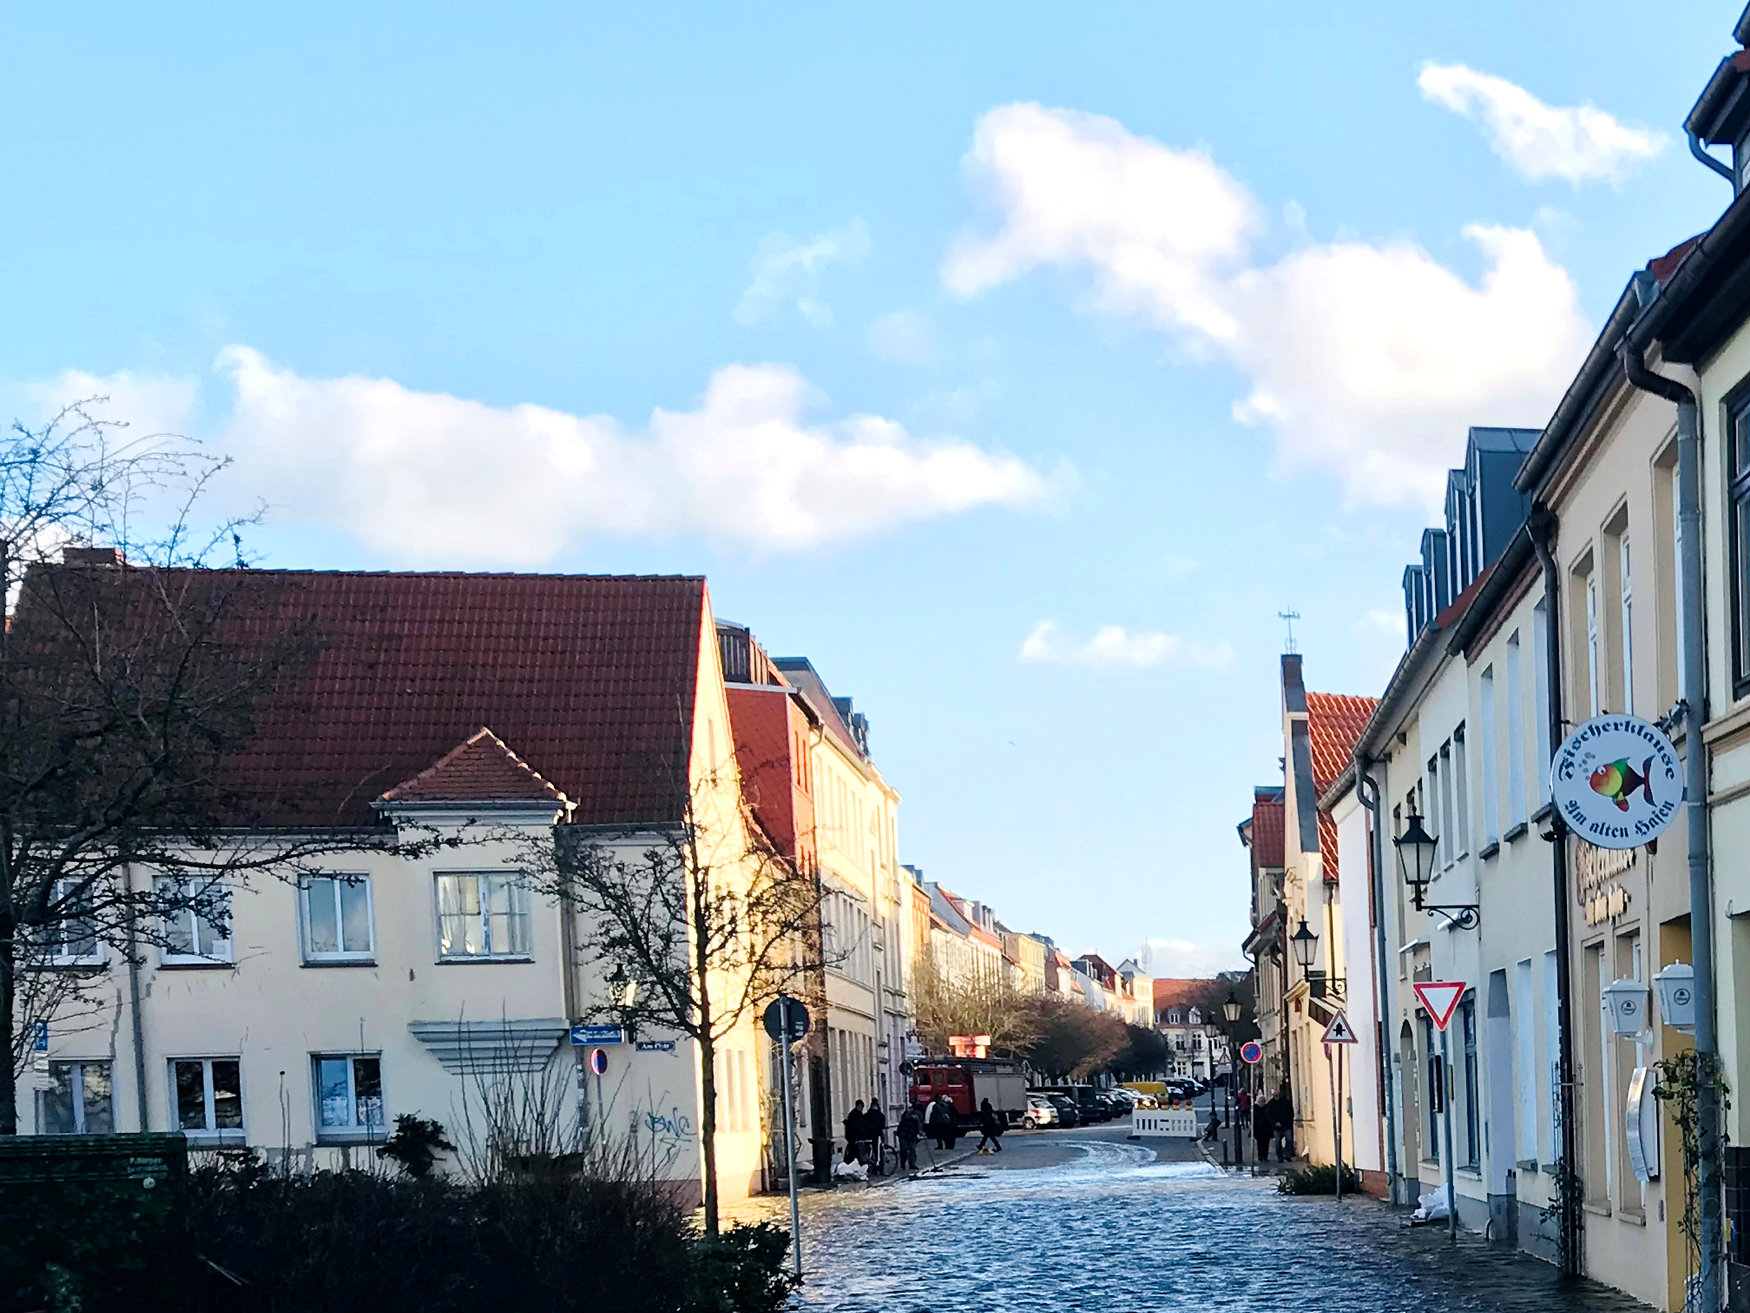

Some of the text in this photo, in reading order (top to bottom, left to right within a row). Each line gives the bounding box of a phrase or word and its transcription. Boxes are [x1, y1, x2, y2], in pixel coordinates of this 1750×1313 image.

[1558, 720, 1676, 782] Fischerklause
[1564, 799, 1676, 839] Am alten Hafen
